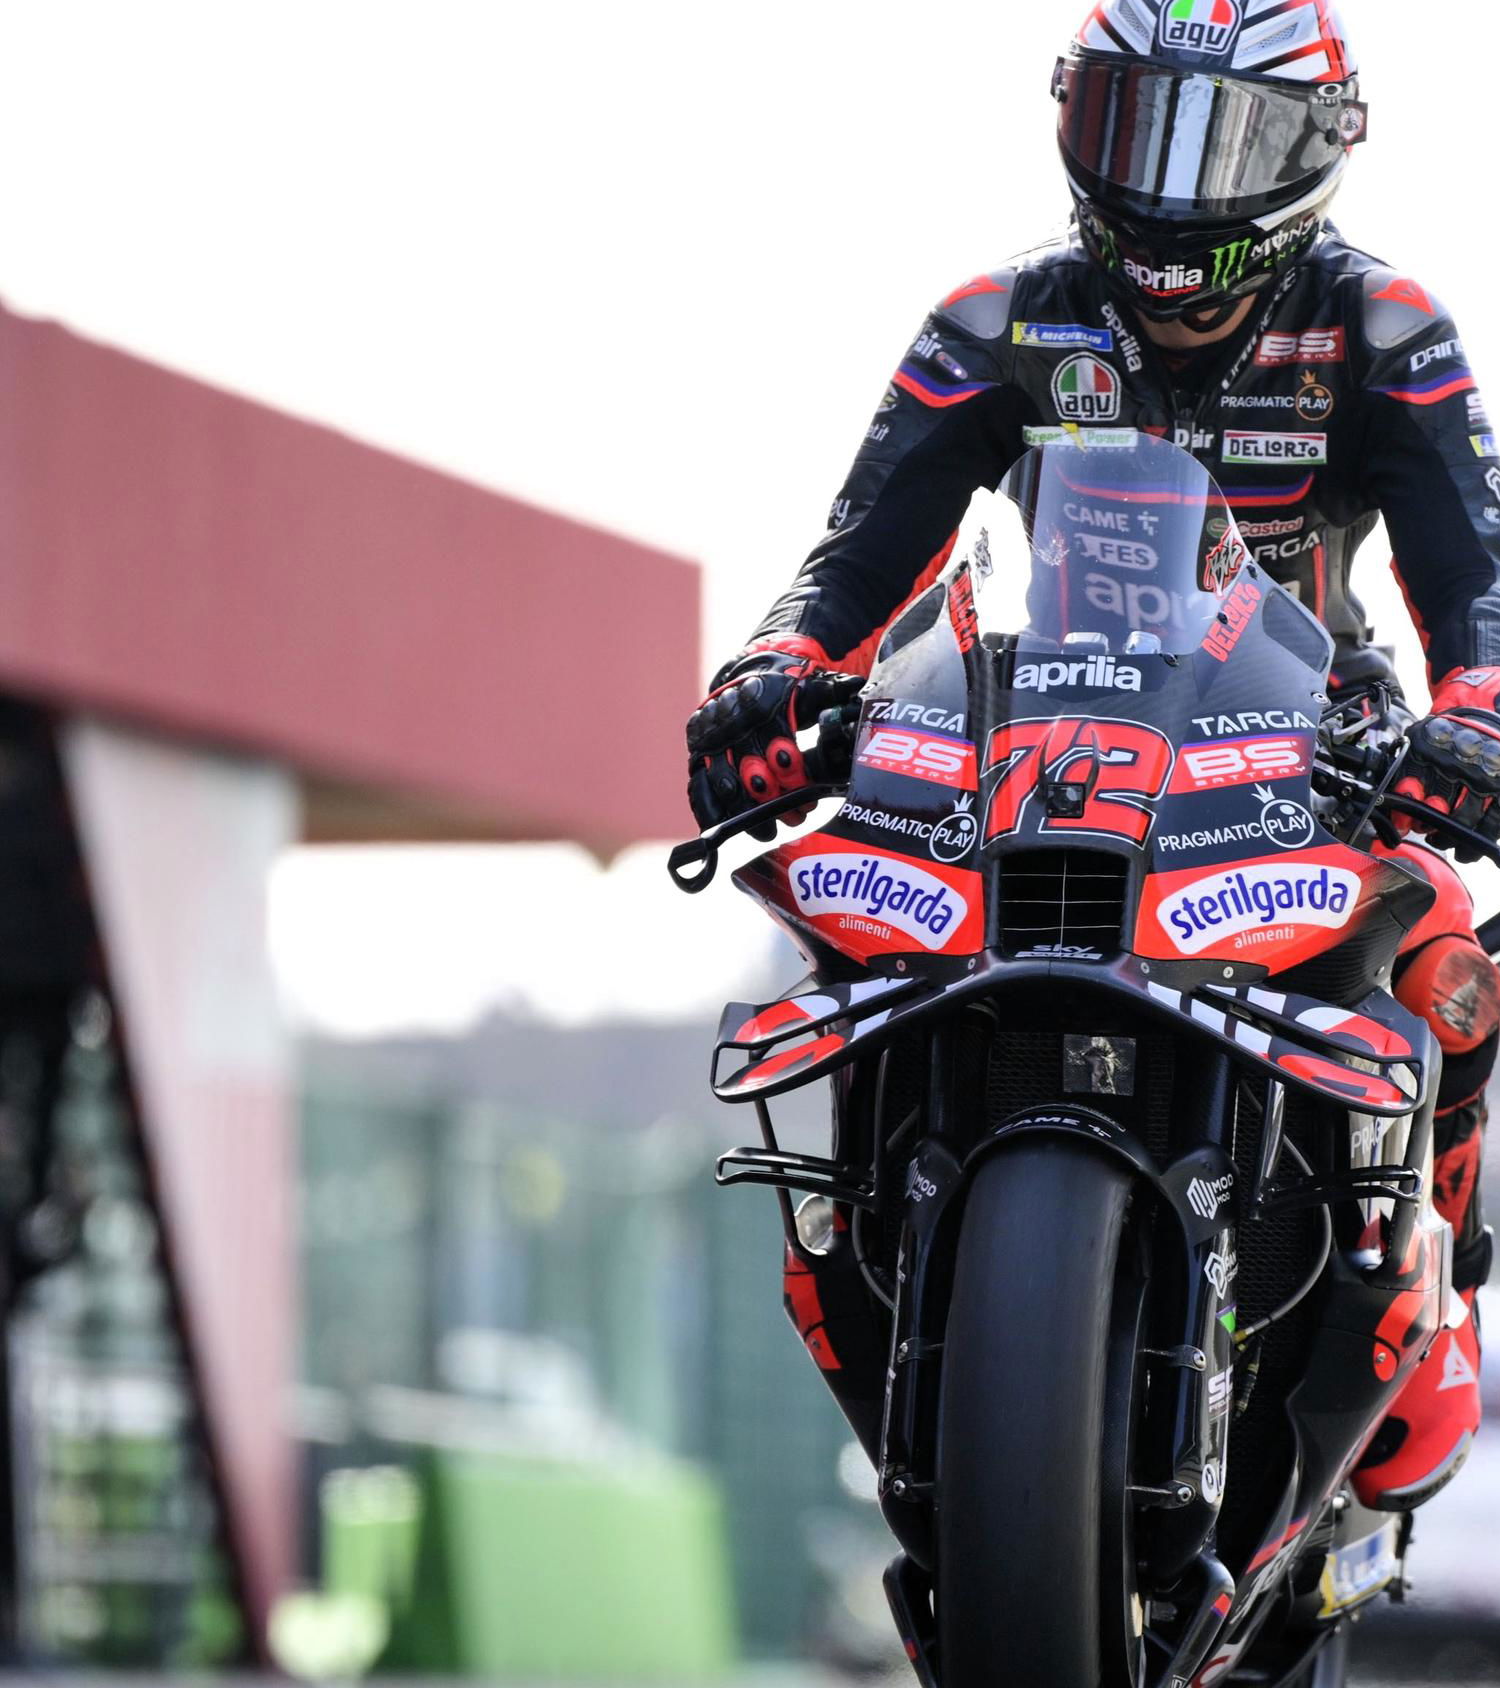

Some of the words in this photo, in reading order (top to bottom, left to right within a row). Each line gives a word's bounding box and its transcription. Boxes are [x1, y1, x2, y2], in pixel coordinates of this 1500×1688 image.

[1168, 18, 1227, 49] agv
[1123, 257, 1204, 290] aprilia
[1040, 330, 1103, 345] MICHELIN
[1100, 301, 1143, 373] aprilia
[1260, 331, 1338, 357] BS
[1065, 394, 1111, 418] agv
[1220, 395, 1295, 409] PRAGMATIC
[1298, 396, 1330, 410] PLAY
[1023, 428, 1063, 443] Green
[1086, 429, 1133, 445] Power
[1063, 502, 1130, 531] CAME
[1237, 516, 1304, 538] Castrol
[1012, 654, 1142, 693] aprilia
[867, 701, 965, 733] TARGA
[1191, 709, 1316, 737] TARGA
[862, 731, 969, 774] BS
[1183, 740, 1301, 780] BS
[856, 755, 955, 781] BATTERY
[980, 714, 1176, 851] 72
[1193, 765, 1306, 787] BATTERY
[838, 802, 934, 840] PRAGMATIC
[934, 827, 973, 848] PLAY
[1157, 821, 1264, 852] PRAGMATIC
[1269, 813, 1309, 835] PLAY
[797, 858, 954, 935] sterilgarda
[1169, 868, 1349, 940] sterilgarda
[838, 915, 892, 941] alimenti
[1234, 925, 1295, 950] alimenti
